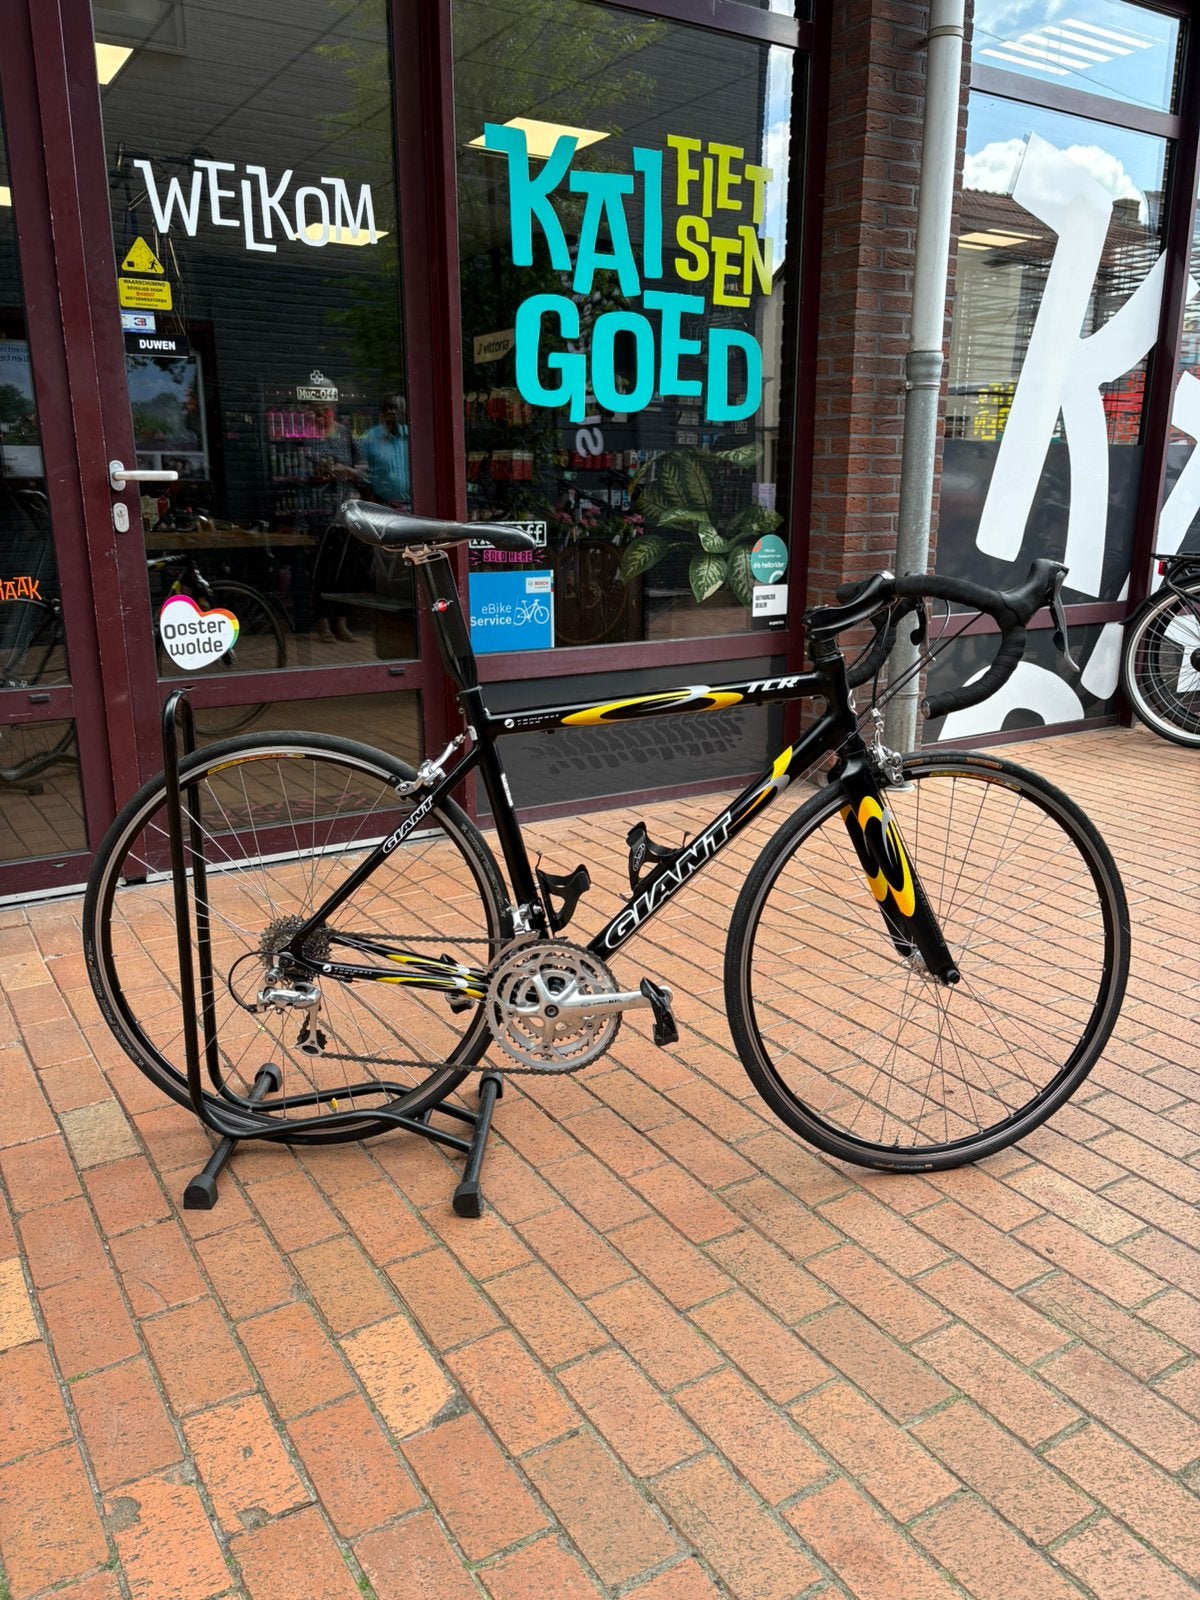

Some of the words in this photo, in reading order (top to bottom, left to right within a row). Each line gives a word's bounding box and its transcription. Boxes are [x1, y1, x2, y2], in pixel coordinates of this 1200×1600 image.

[667, 134, 774, 224] FIET
[134, 159, 378, 253] WELKOM
[484, 122, 662, 297] KAI
[674, 215, 774, 308] SEN
[138, 339, 176, 351] DUWEN
[515, 290, 763, 423] GOED
[298, 388, 337, 399] Muc-Off
[484, 550, 507, 562] SOLD
[508, 550, 533, 563] HERE
[470, 615, 512, 627] Service
[481, 602, 512, 614] eBike
[169, 636, 224, 657] wolde
[747, 675, 800, 693] TCR
[382, 794, 433, 854] GIANT
[605, 811, 732, 949] GIANT
